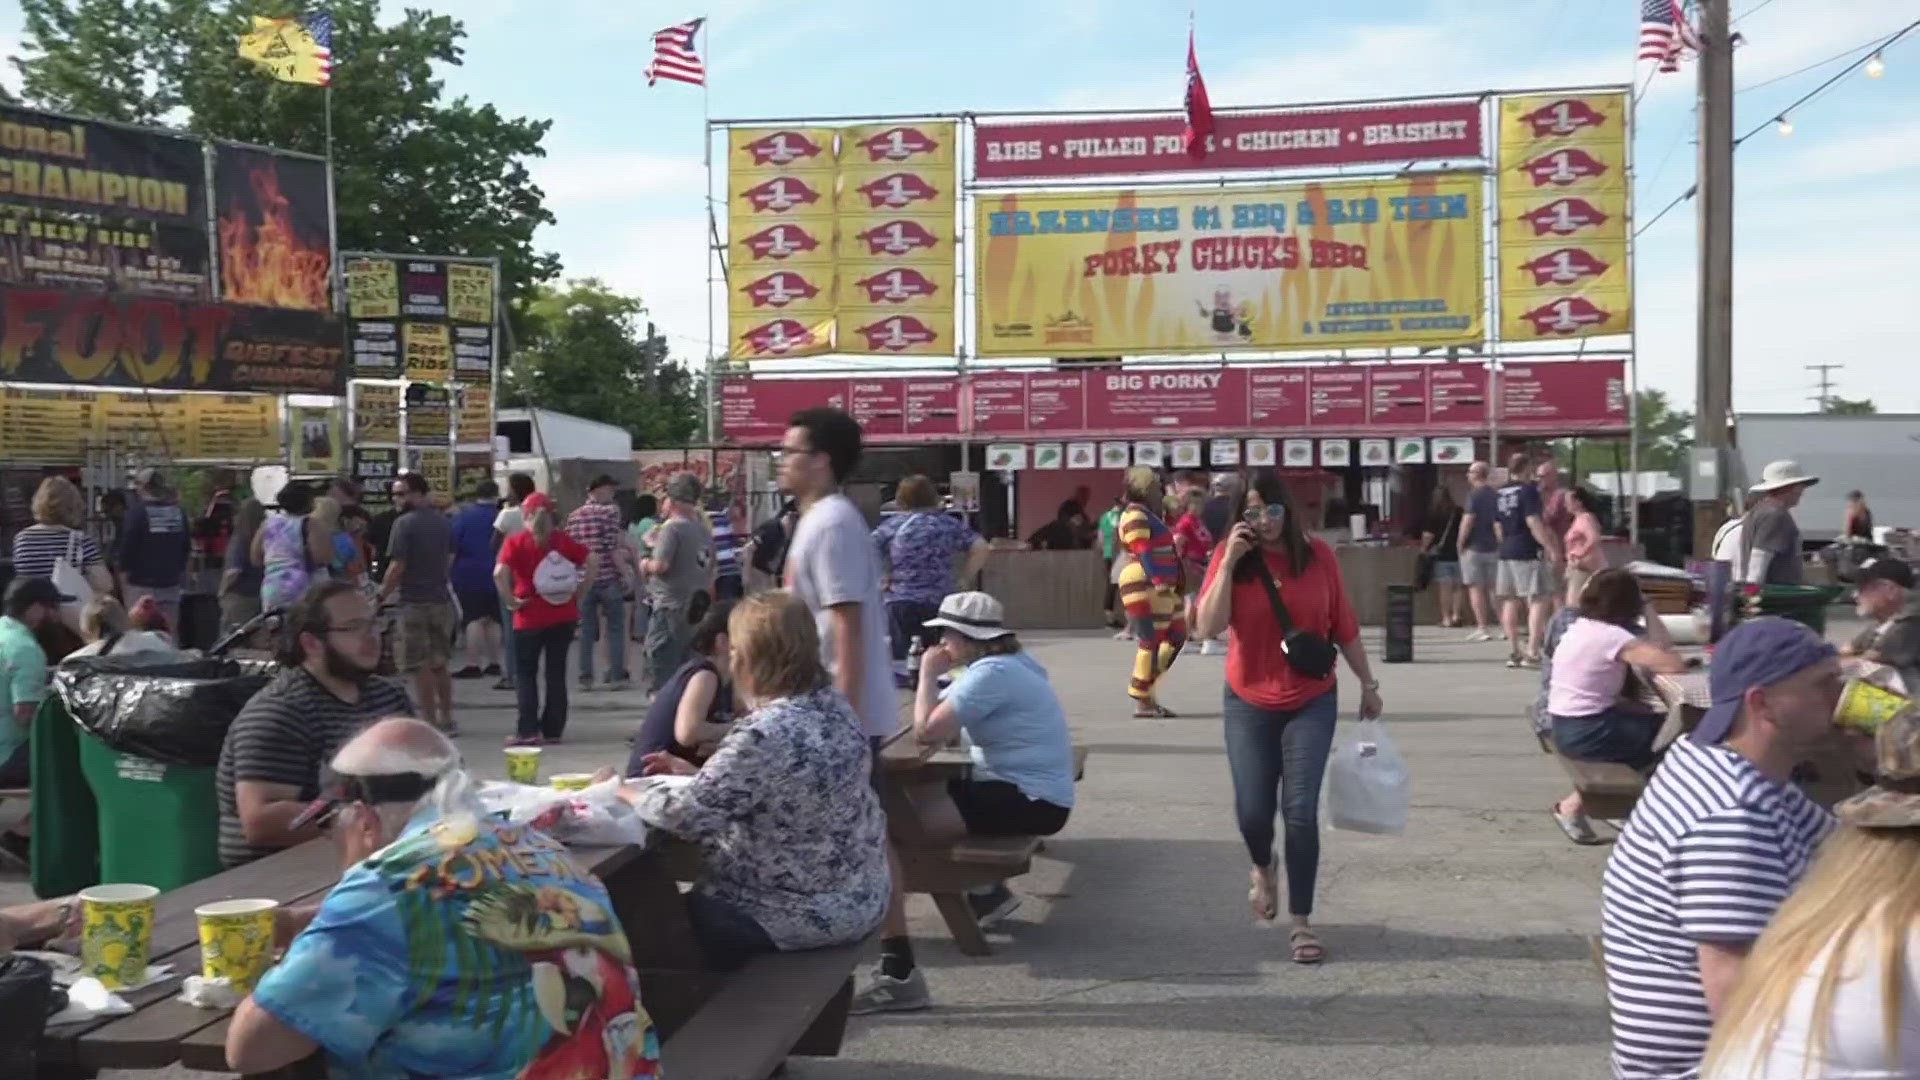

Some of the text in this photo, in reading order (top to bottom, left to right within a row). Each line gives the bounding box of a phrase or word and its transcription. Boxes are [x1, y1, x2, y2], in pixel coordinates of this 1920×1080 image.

[986, 141, 1041, 161] RIBS
[1064, 137, 1146, 158] PULLED
[1237, 128, 1340, 150] CHICKEN
[1363, 120, 1467, 145] BRISKET
[990, 207, 1179, 236] ARKANSAS
[1193, 205, 1221, 229] #1
[1232, 203, 1287, 232] BBQ
[1328, 197, 1379, 225] RIB
[1388, 194, 1468, 221] TEAM
[1084, 236, 1369, 277] PORKY CHICKS BBQ
[0, 289, 234, 384] FOOT
[1106, 373, 1222, 390] BIG PORKY
